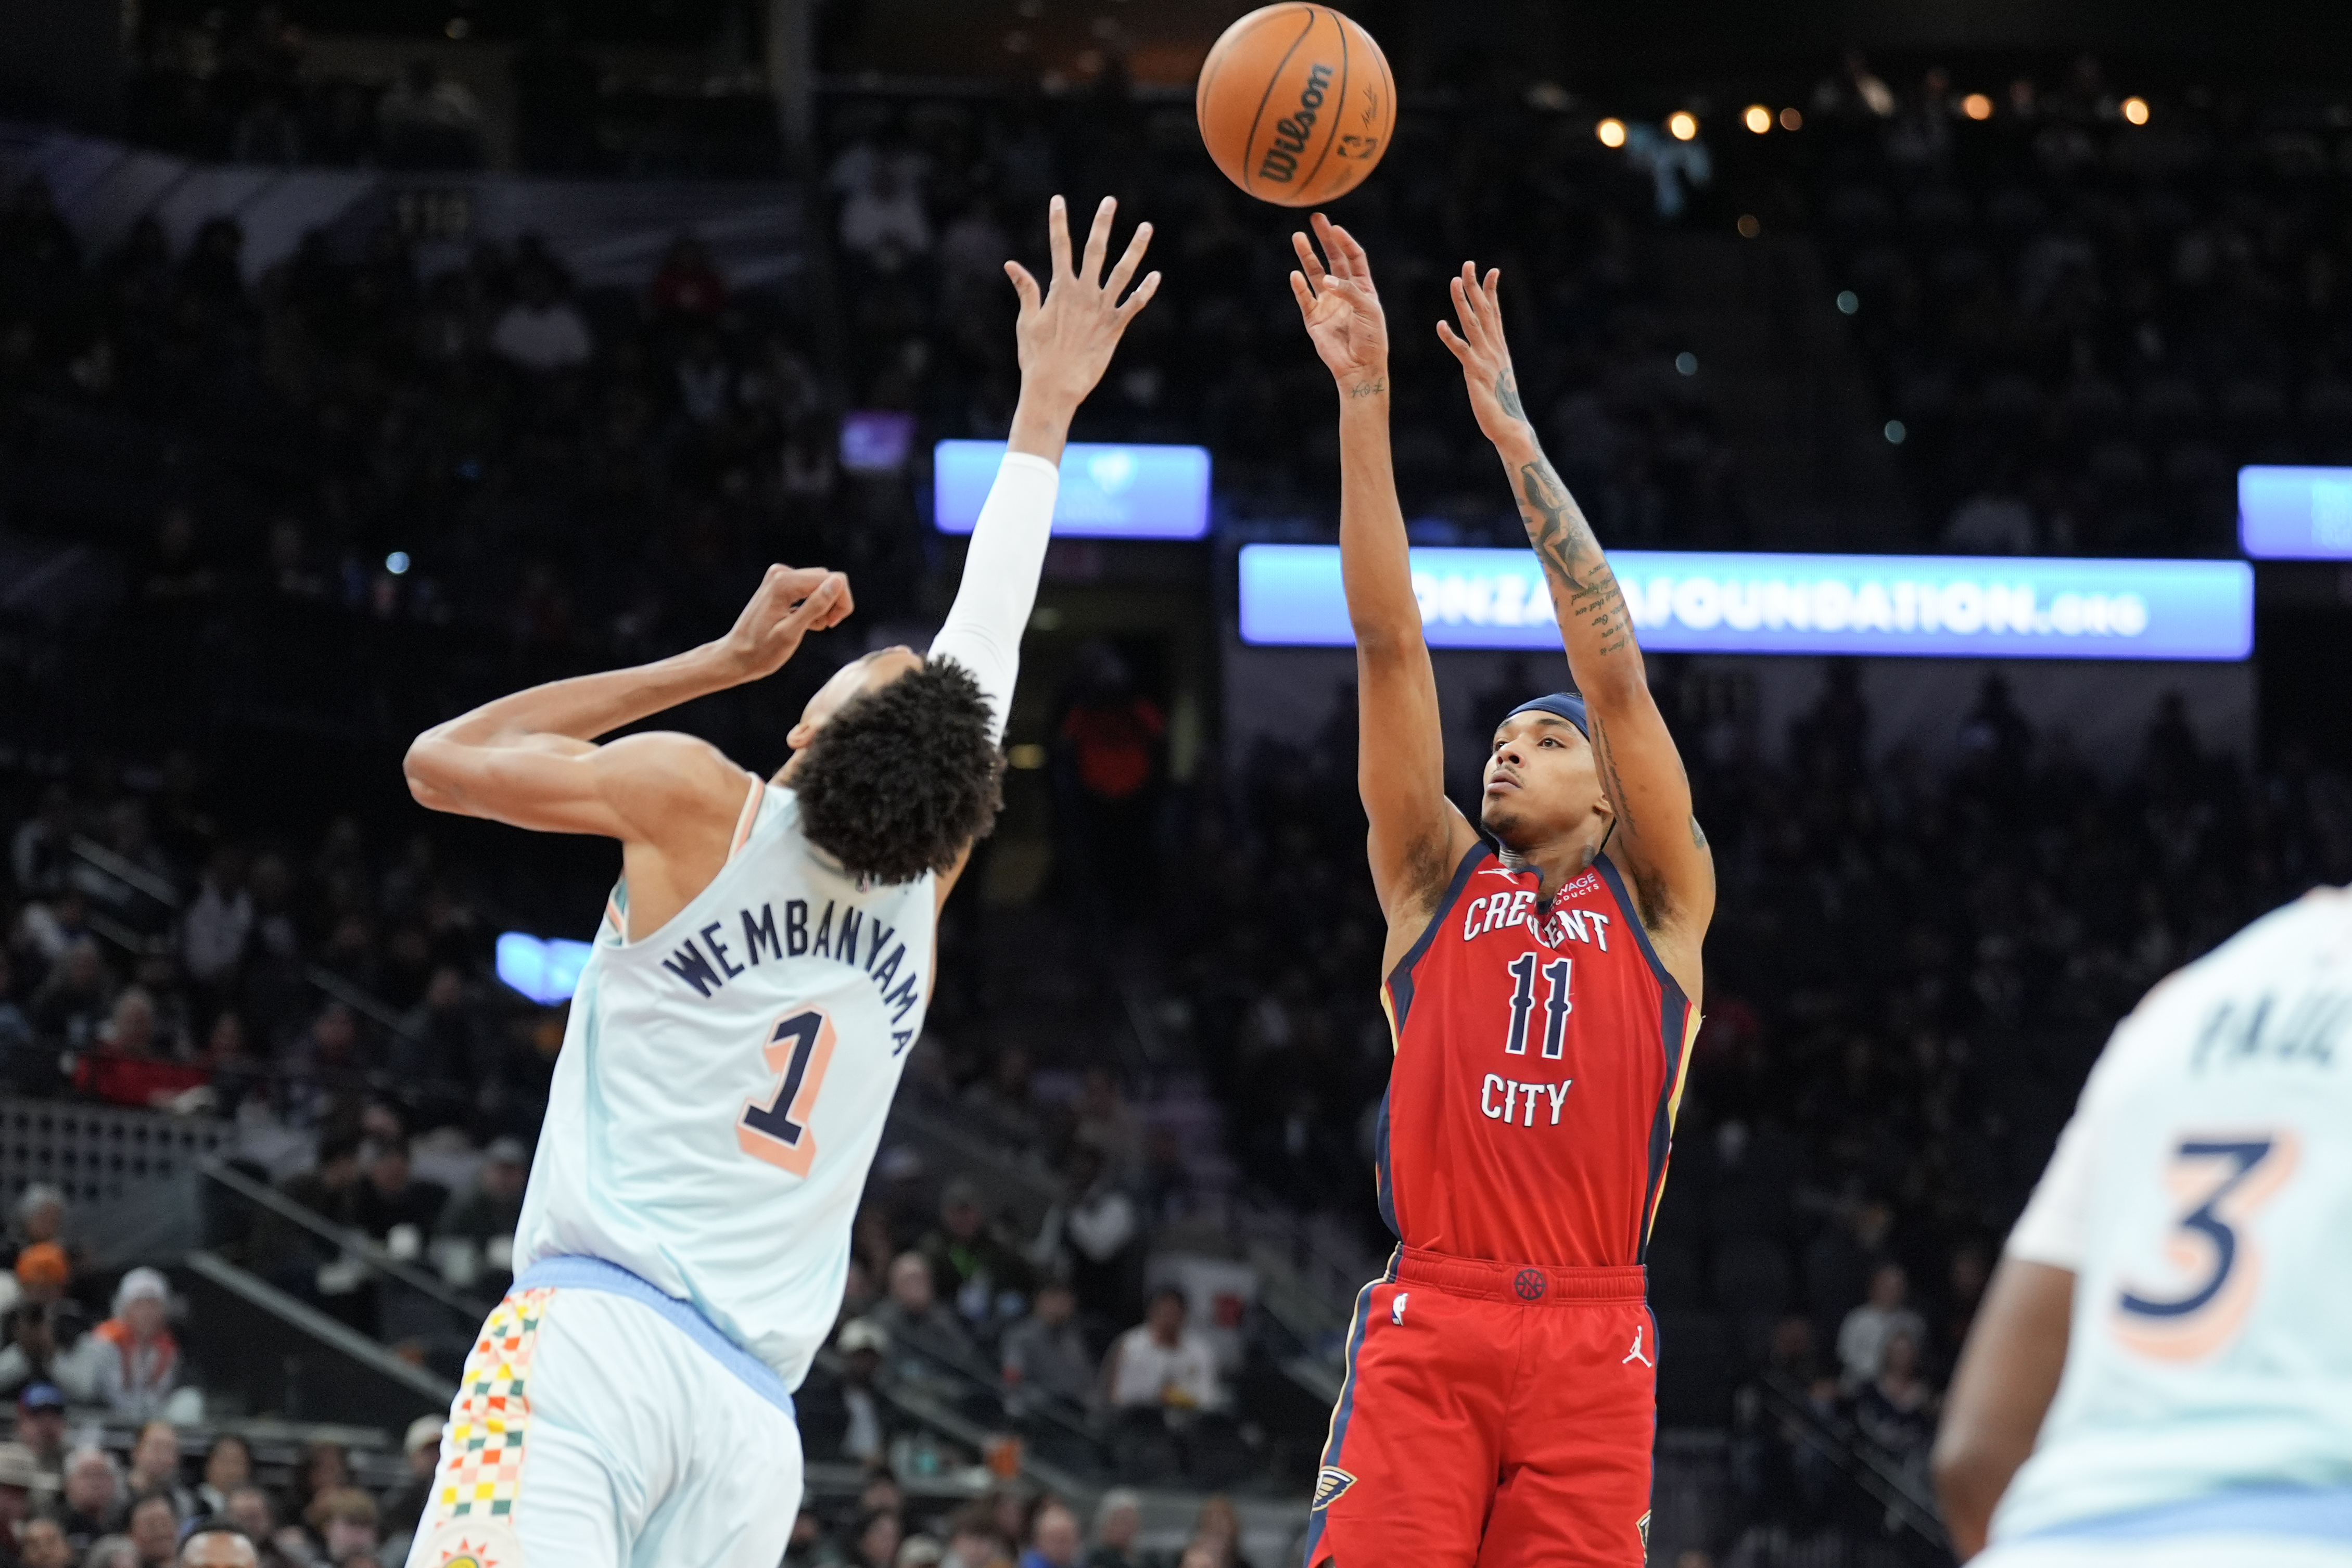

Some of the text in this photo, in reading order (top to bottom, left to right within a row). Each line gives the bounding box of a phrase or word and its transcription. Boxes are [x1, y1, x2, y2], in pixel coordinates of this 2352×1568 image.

[1258, 63, 1333, 183] Wilson
[662, 899, 918, 1057] WEMBANYAMA
[1505, 951, 1572, 1060] 11
[738, 1007, 831, 1163] 1
[1481, 1073, 1572, 1127] CITY
[2115, 1134, 2287, 1337] 3
